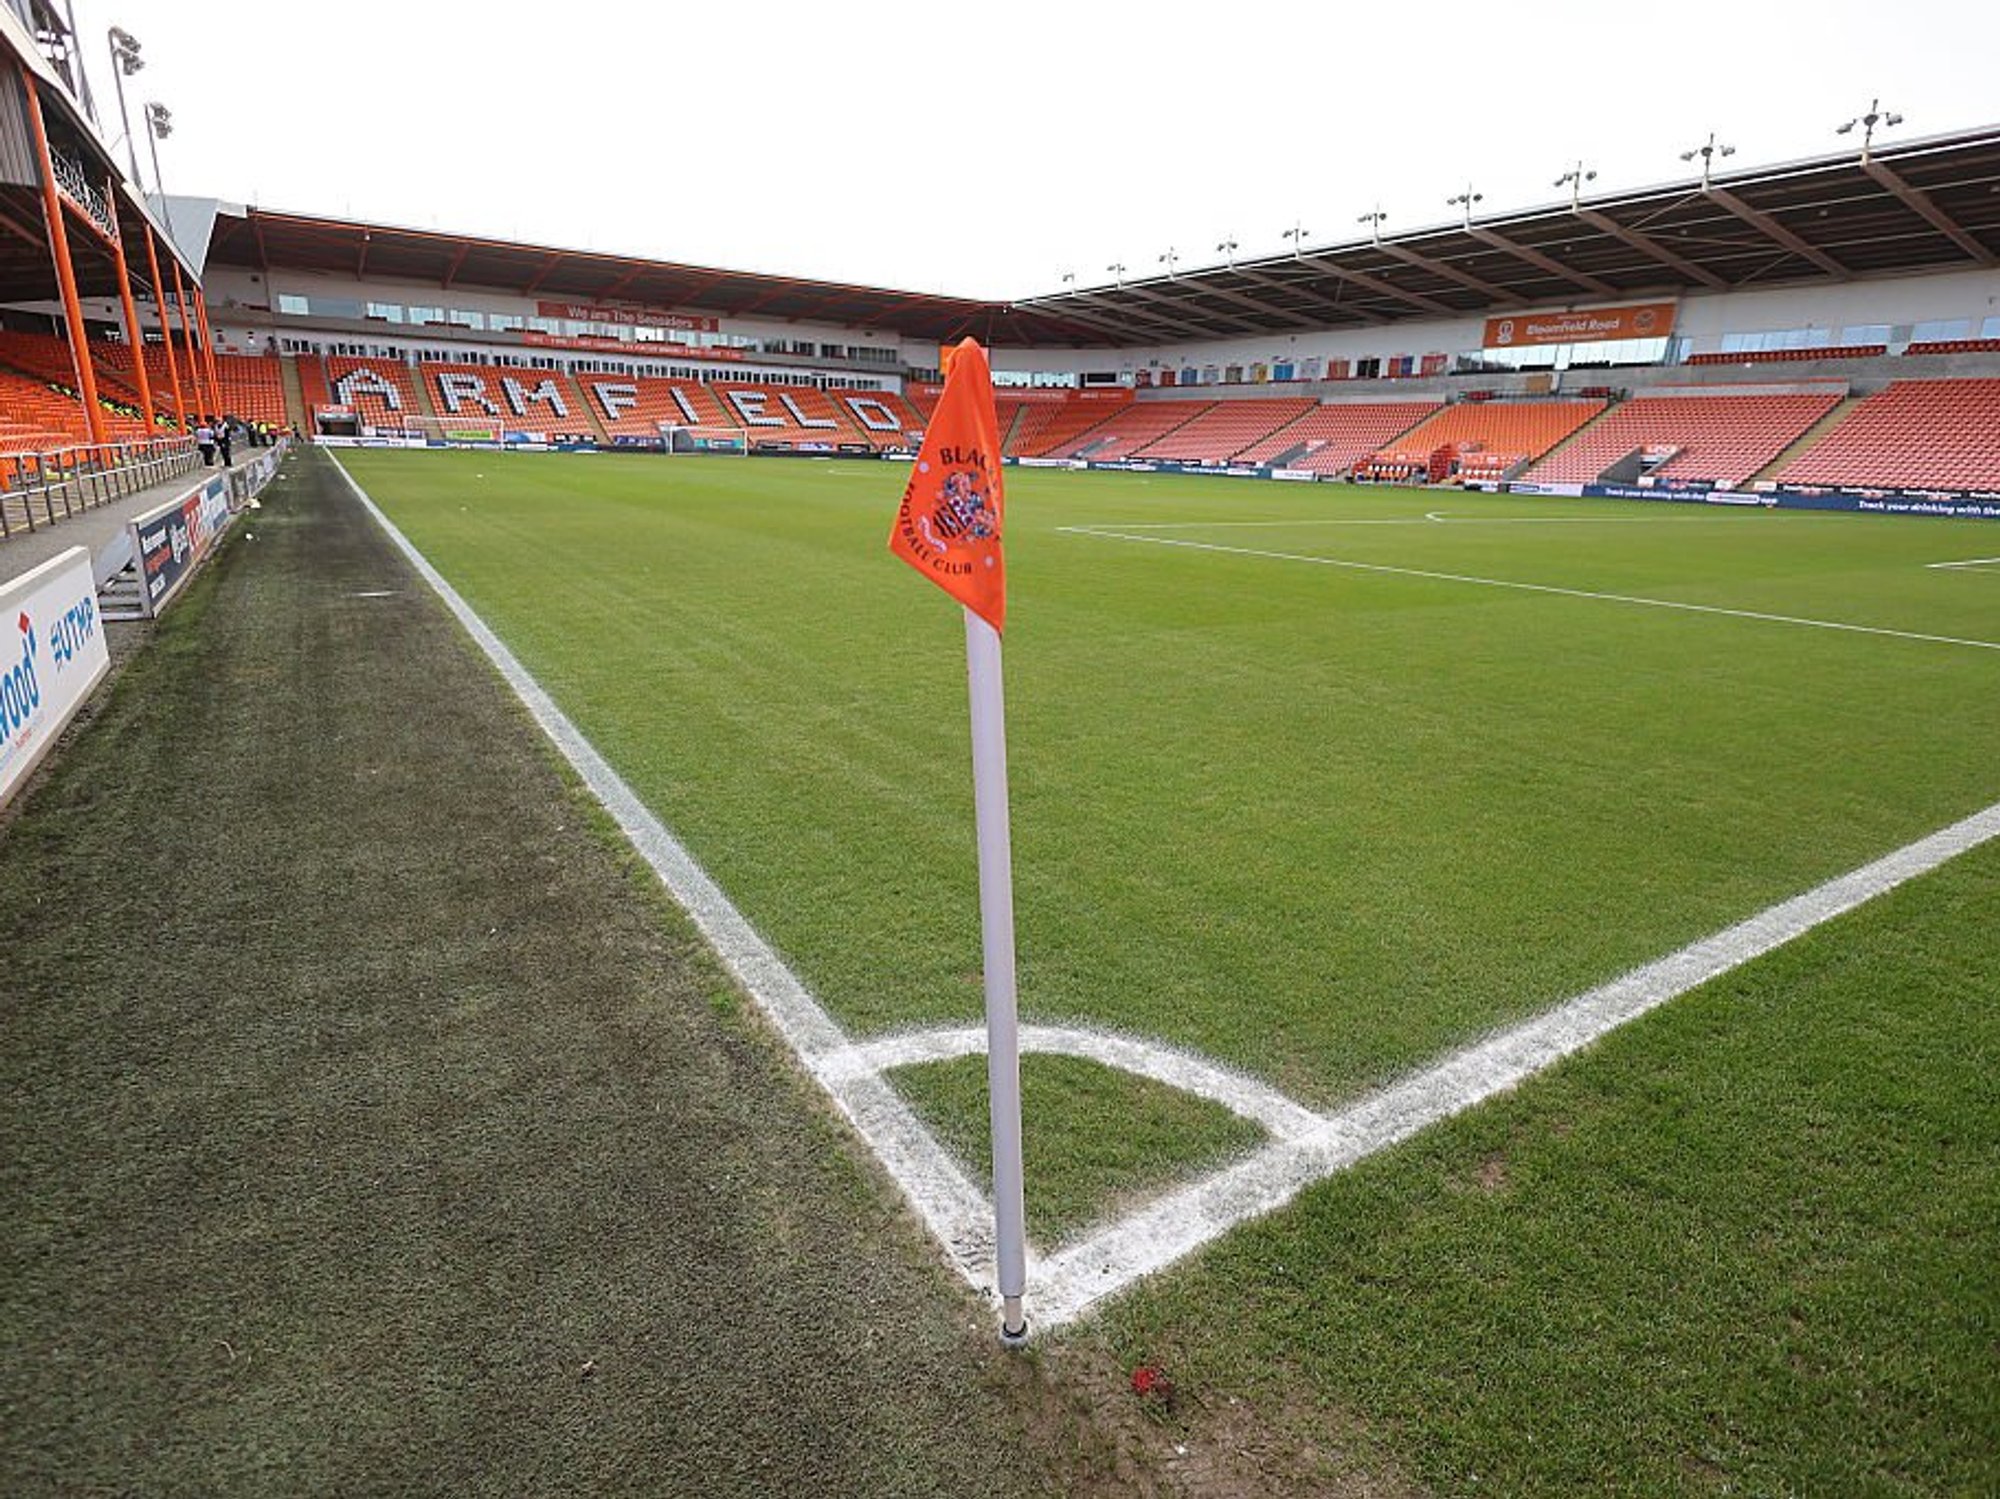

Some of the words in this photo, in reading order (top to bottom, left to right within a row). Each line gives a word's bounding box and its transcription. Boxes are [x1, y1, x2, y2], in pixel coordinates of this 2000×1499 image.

[568, 305, 588, 320] We
[613, 310, 635, 323] The
[1526, 319, 1587, 335] Bloomfield
[1588, 317, 1620, 331] Road
[336, 367, 902, 430] ARMFIELD
[1859, 500, 1885, 510] Track
[1887, 503, 1909, 513] your
[1910, 502, 1955, 516] drinking
[1956, 504, 1981, 515] with
[933, 558, 973, 576] CLUB
